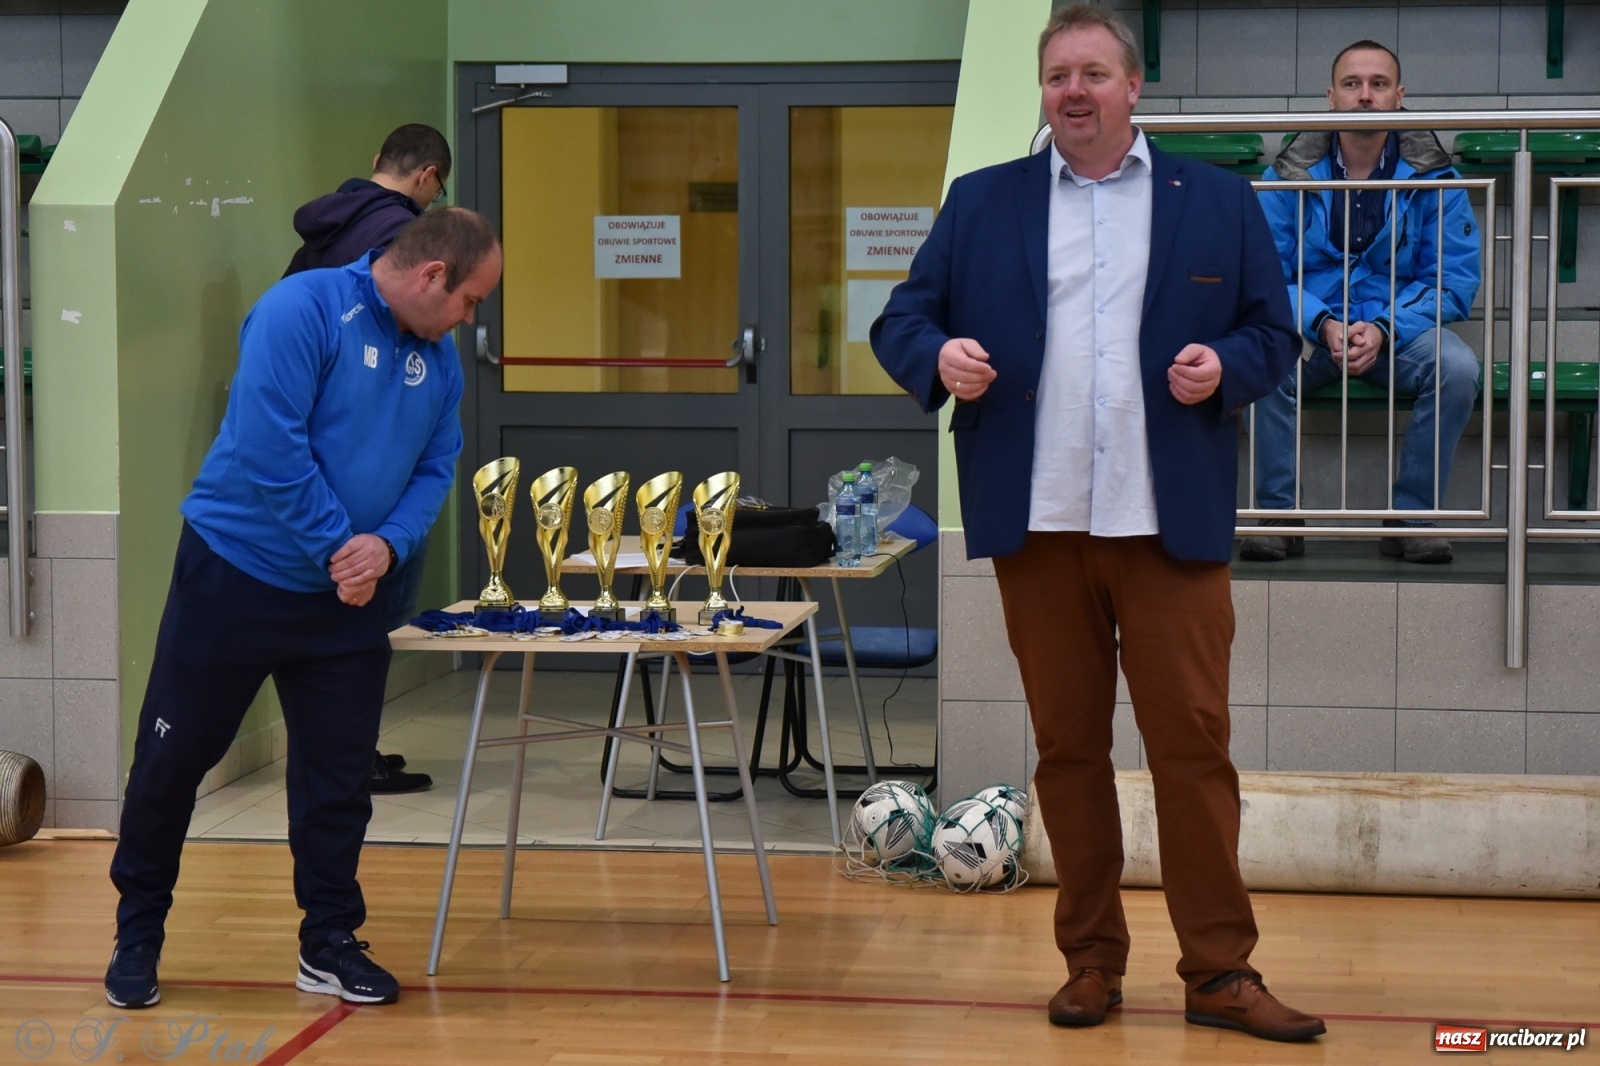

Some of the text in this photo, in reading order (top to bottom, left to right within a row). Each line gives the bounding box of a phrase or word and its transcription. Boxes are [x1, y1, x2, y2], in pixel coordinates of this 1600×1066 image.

[860, 212, 919, 222] OBOWIĄZUJE
[608, 221, 666, 231] OBOWIĄZUJE
[849, 229, 882, 237] OBUWIE
[597, 237, 677, 246] OBUWIE SPORTOWE
[866, 246, 916, 256] ZMIENNE
[614, 254, 663, 264] ZMIENNE
[363, 344, 378, 369] MB
